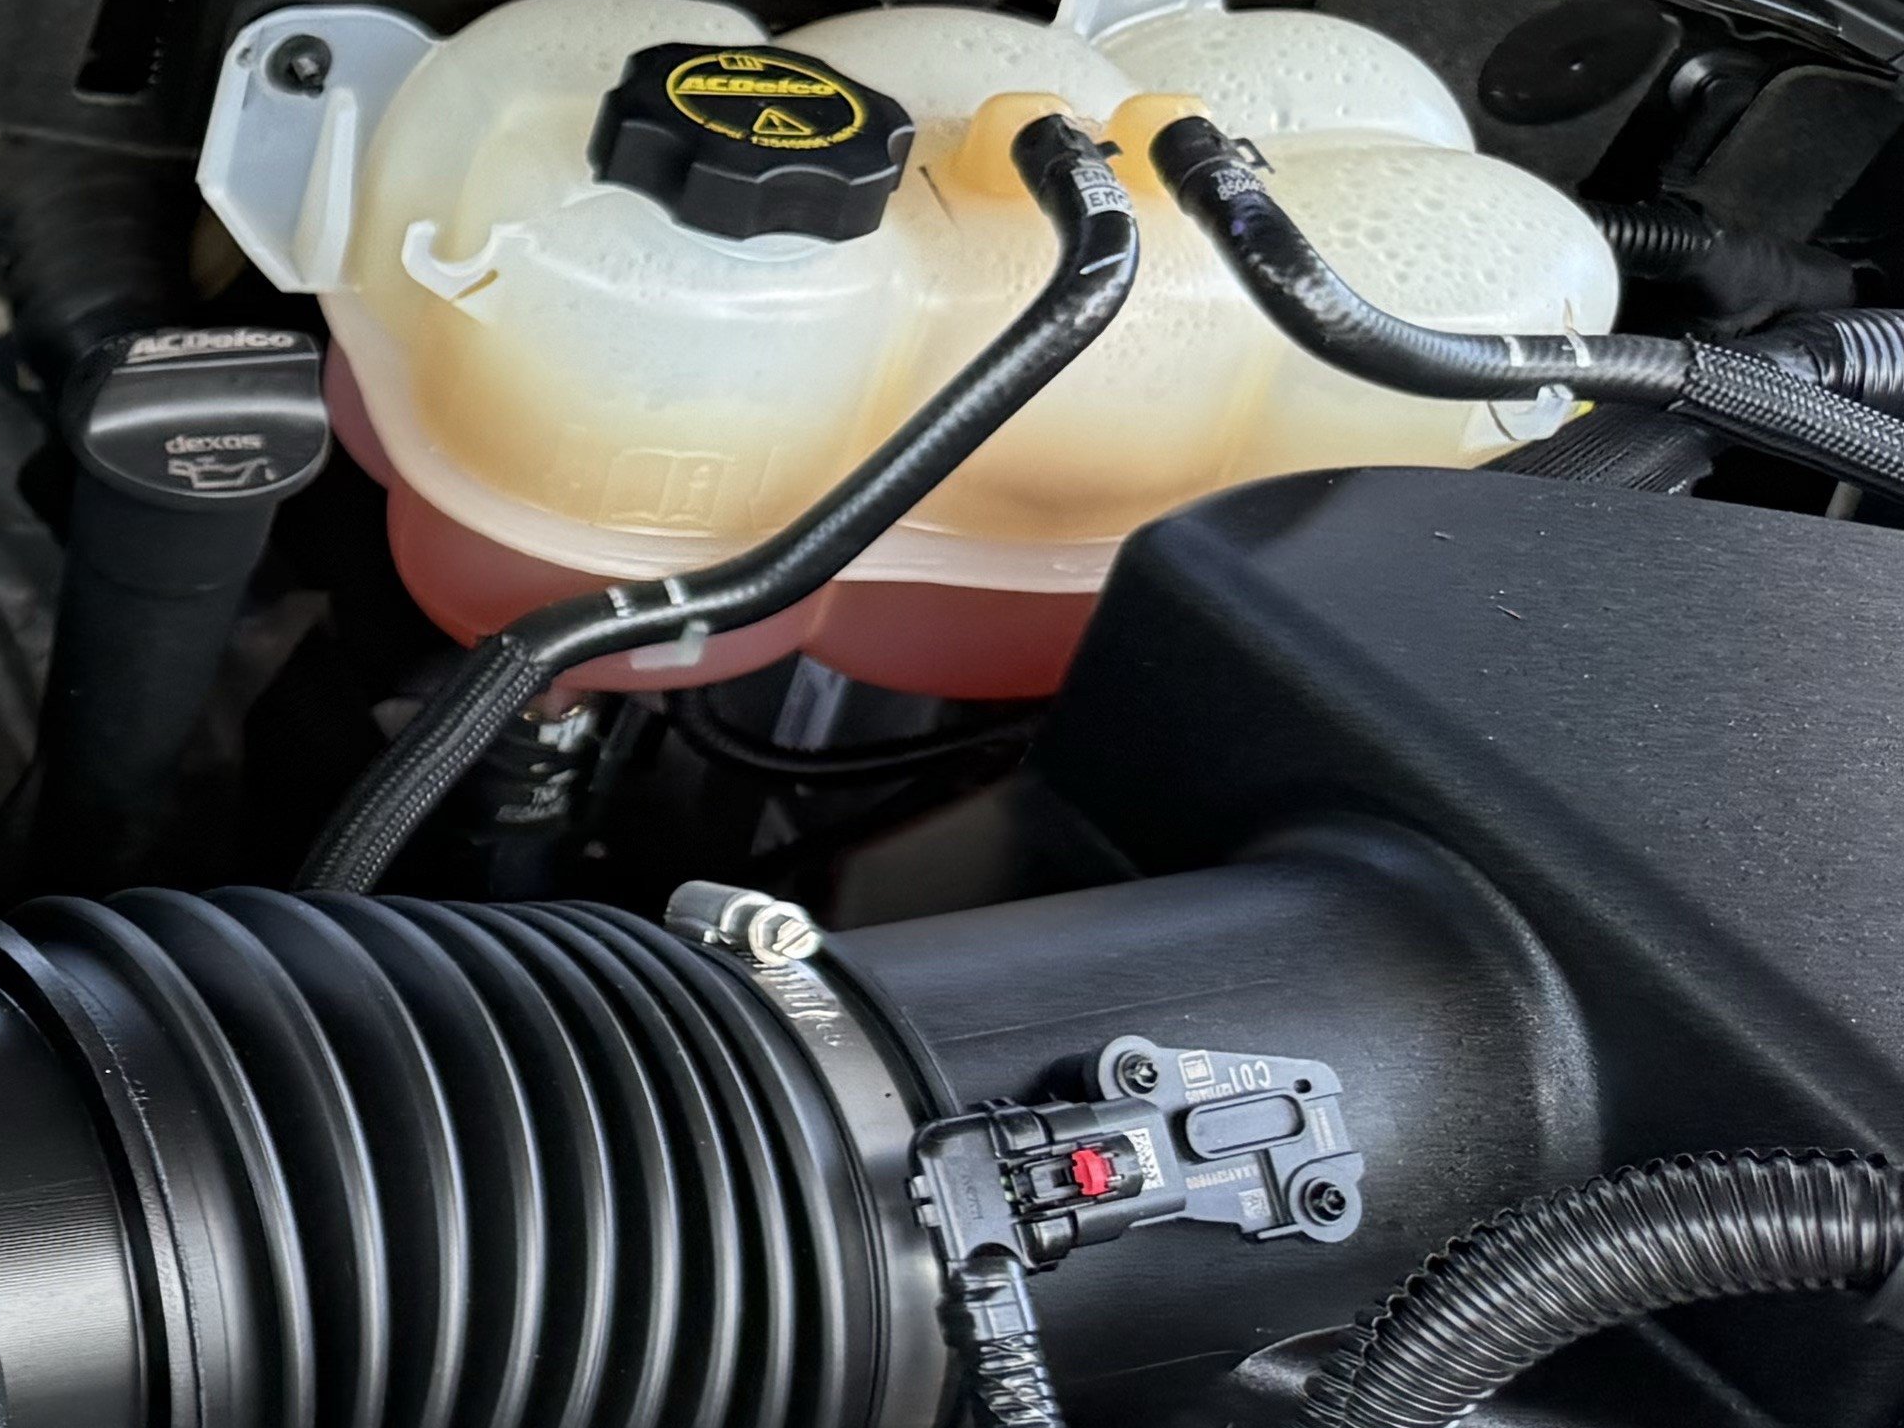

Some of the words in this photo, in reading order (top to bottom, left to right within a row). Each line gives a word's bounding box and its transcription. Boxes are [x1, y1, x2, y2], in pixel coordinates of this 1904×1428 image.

[676, 75, 838, 97] ACDelco
[127, 329, 295, 360] ACDelco
[165, 435, 264, 455] dexos
[1229, 1060, 1272, 1092] C01
